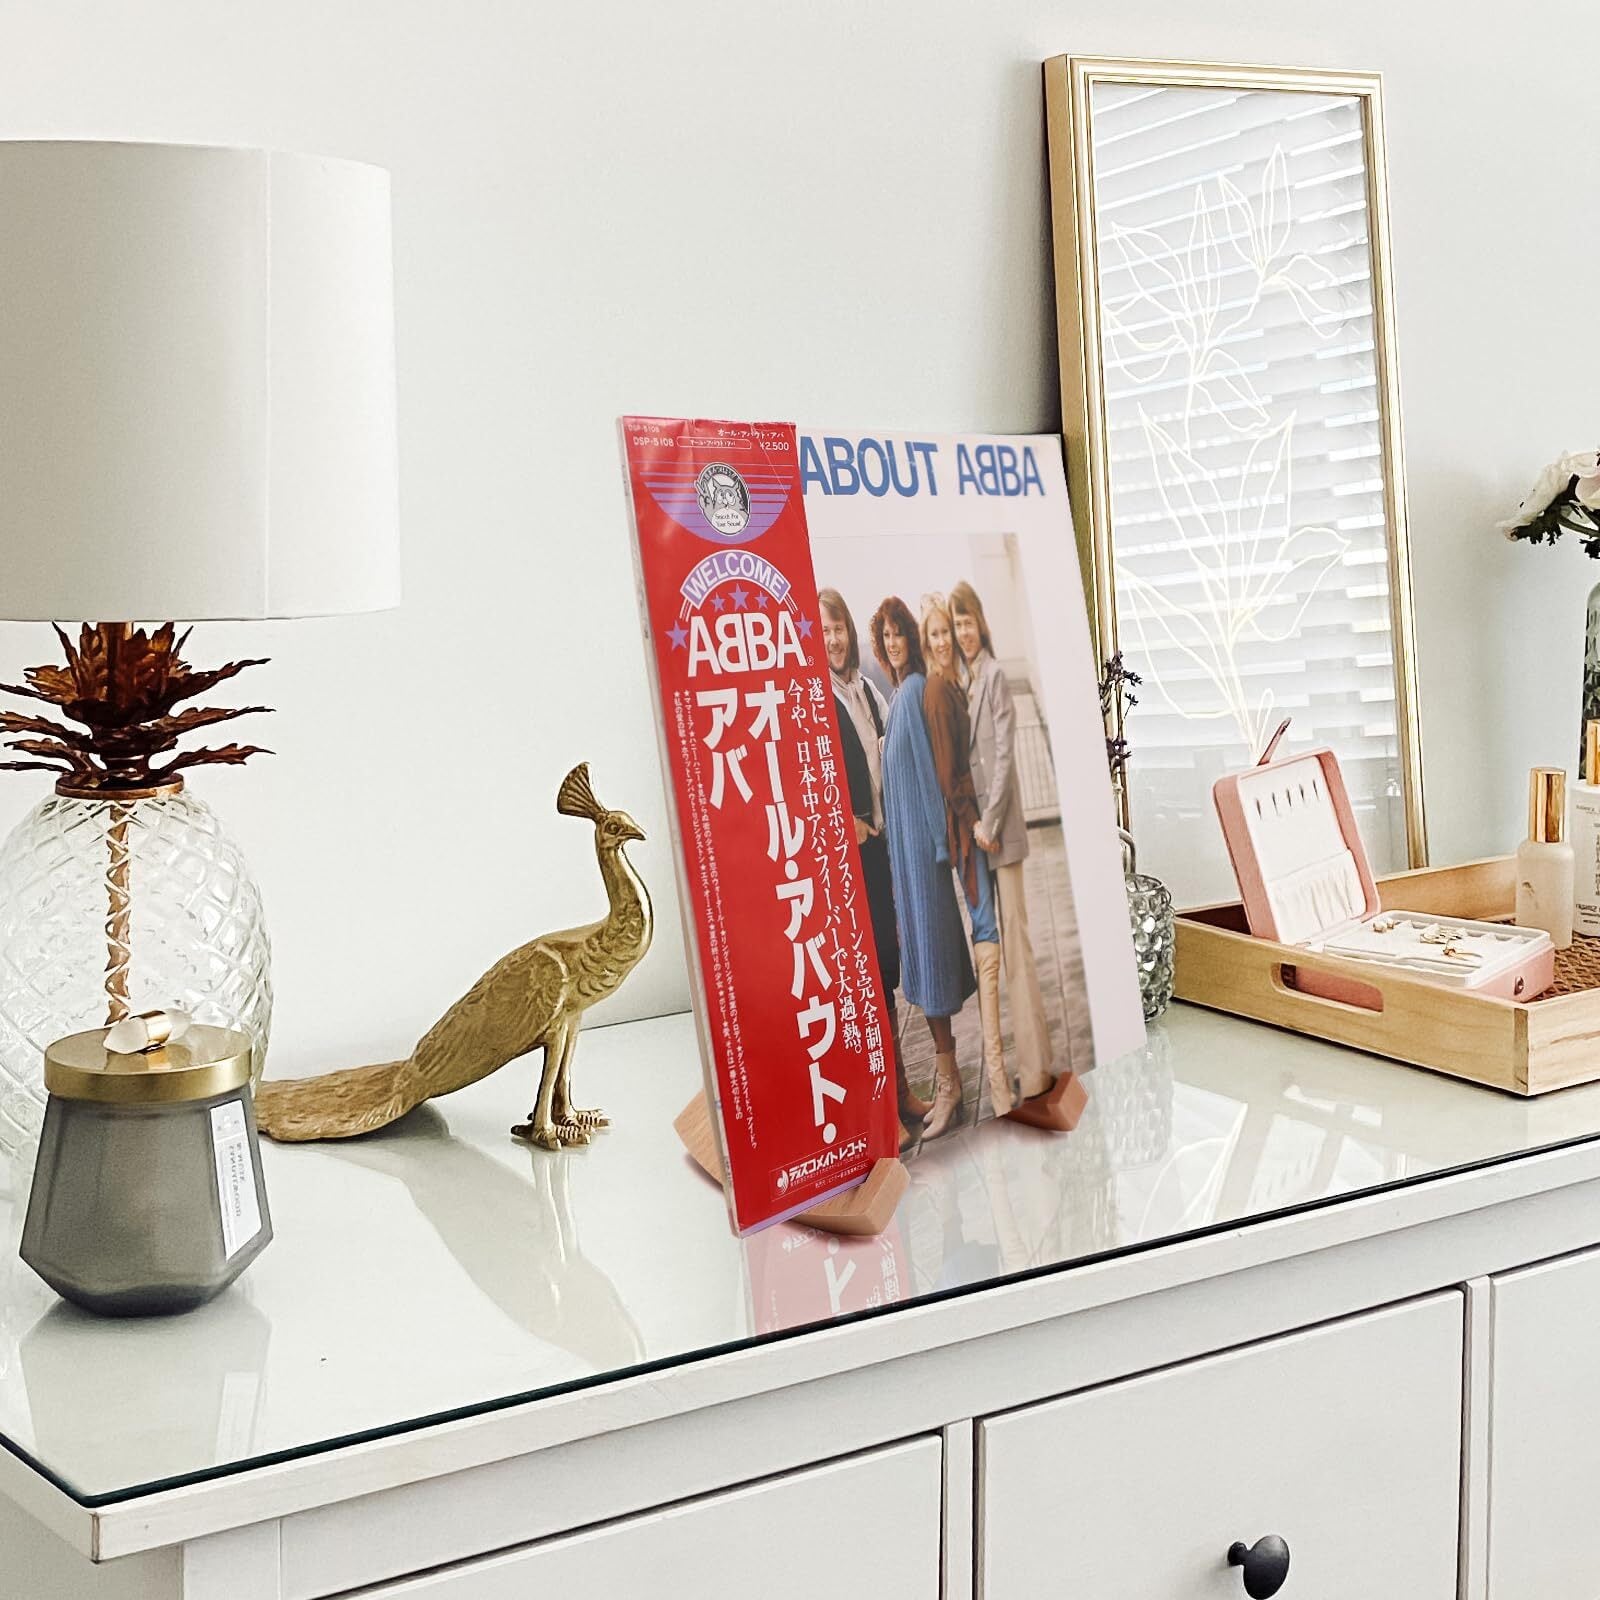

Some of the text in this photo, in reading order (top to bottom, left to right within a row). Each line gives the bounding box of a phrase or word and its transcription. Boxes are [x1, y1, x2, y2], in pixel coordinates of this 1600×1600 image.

[633, 436, 674, 447] DSP-5108
[800, 435, 1045, 497] ABOUT ABBA
[686, 552, 785, 598] WELCOME
[688, 611, 808, 678] ABBA
[696, 687, 753, 810] アバ
